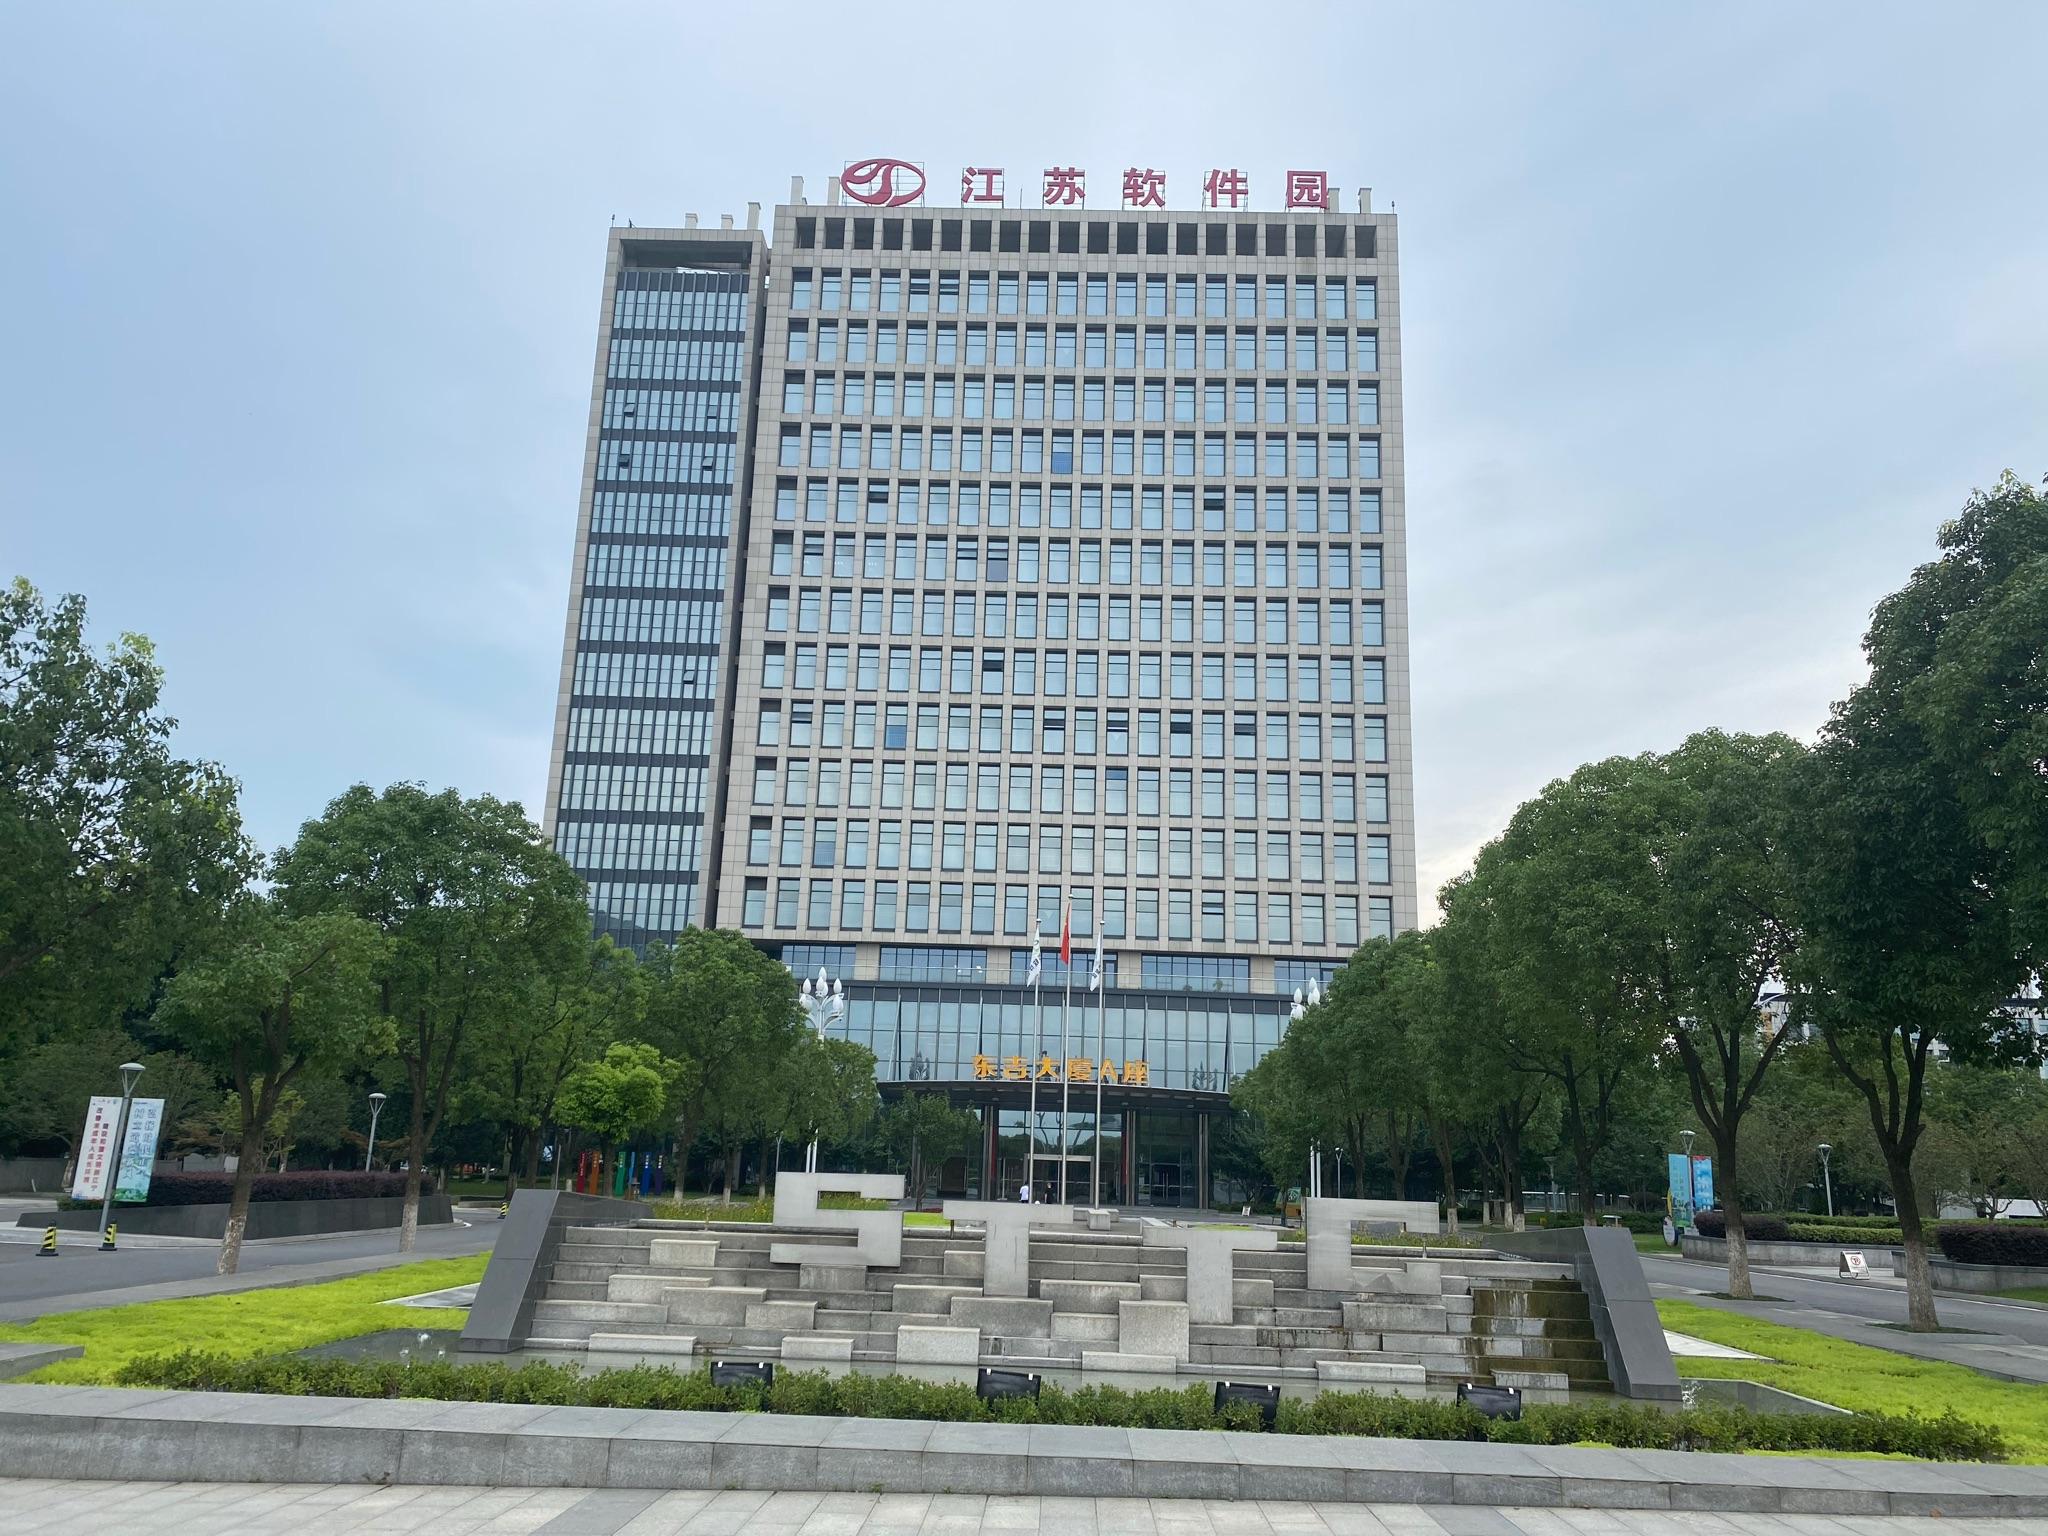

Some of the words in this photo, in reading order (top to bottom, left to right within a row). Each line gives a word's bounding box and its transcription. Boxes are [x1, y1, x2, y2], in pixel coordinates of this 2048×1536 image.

[963, 167, 1327, 209] 江苏软件园
